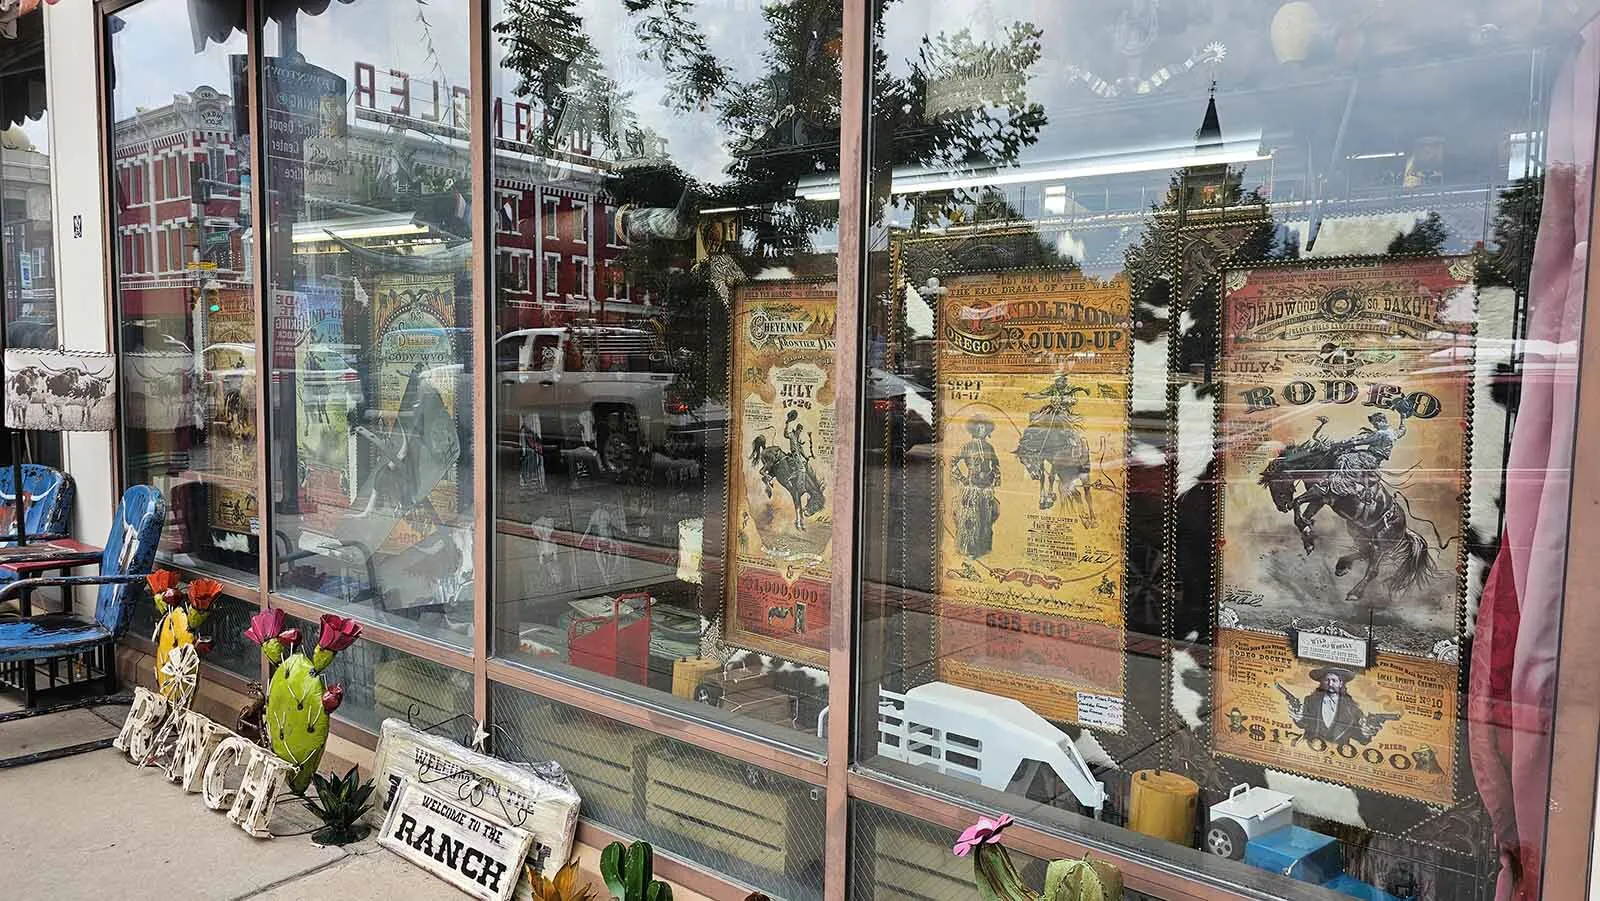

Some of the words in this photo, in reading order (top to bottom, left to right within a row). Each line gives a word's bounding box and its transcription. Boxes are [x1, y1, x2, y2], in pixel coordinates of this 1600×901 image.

[951, 287, 970, 296] THE
[975, 286, 998, 295] EPIC
[1002, 283, 1038, 294] DRAMA
[1043, 283, 1058, 292] OF
[1064, 282, 1086, 291] THE
[1093, 280, 1123, 290] WEST
[1246, 298, 1317, 332] DEADWOOD
[750, 313, 804, 341] CHEYENNE
[775, 336, 816, 351] FRONTIER
[946, 327, 1004, 355] OREGON
[388, 353, 416, 361] CODY
[1230, 361, 1271, 374] JULY
[780, 384, 813, 398] JULY
[948, 379, 984, 391] SEPT
[1238, 379, 1442, 419] RODEO
[1377, 672, 1393, 681] LOCAL
[1250, 714, 1270, 725] TOTAL
[1271, 719, 1292, 729] PURSE
[1247, 722, 1412, 770] $170,000
[422, 795, 467, 827] WELCOME
[470, 819, 480, 832] TO
[482, 825, 503, 845] THE
[394, 812, 508, 894] RANCH
